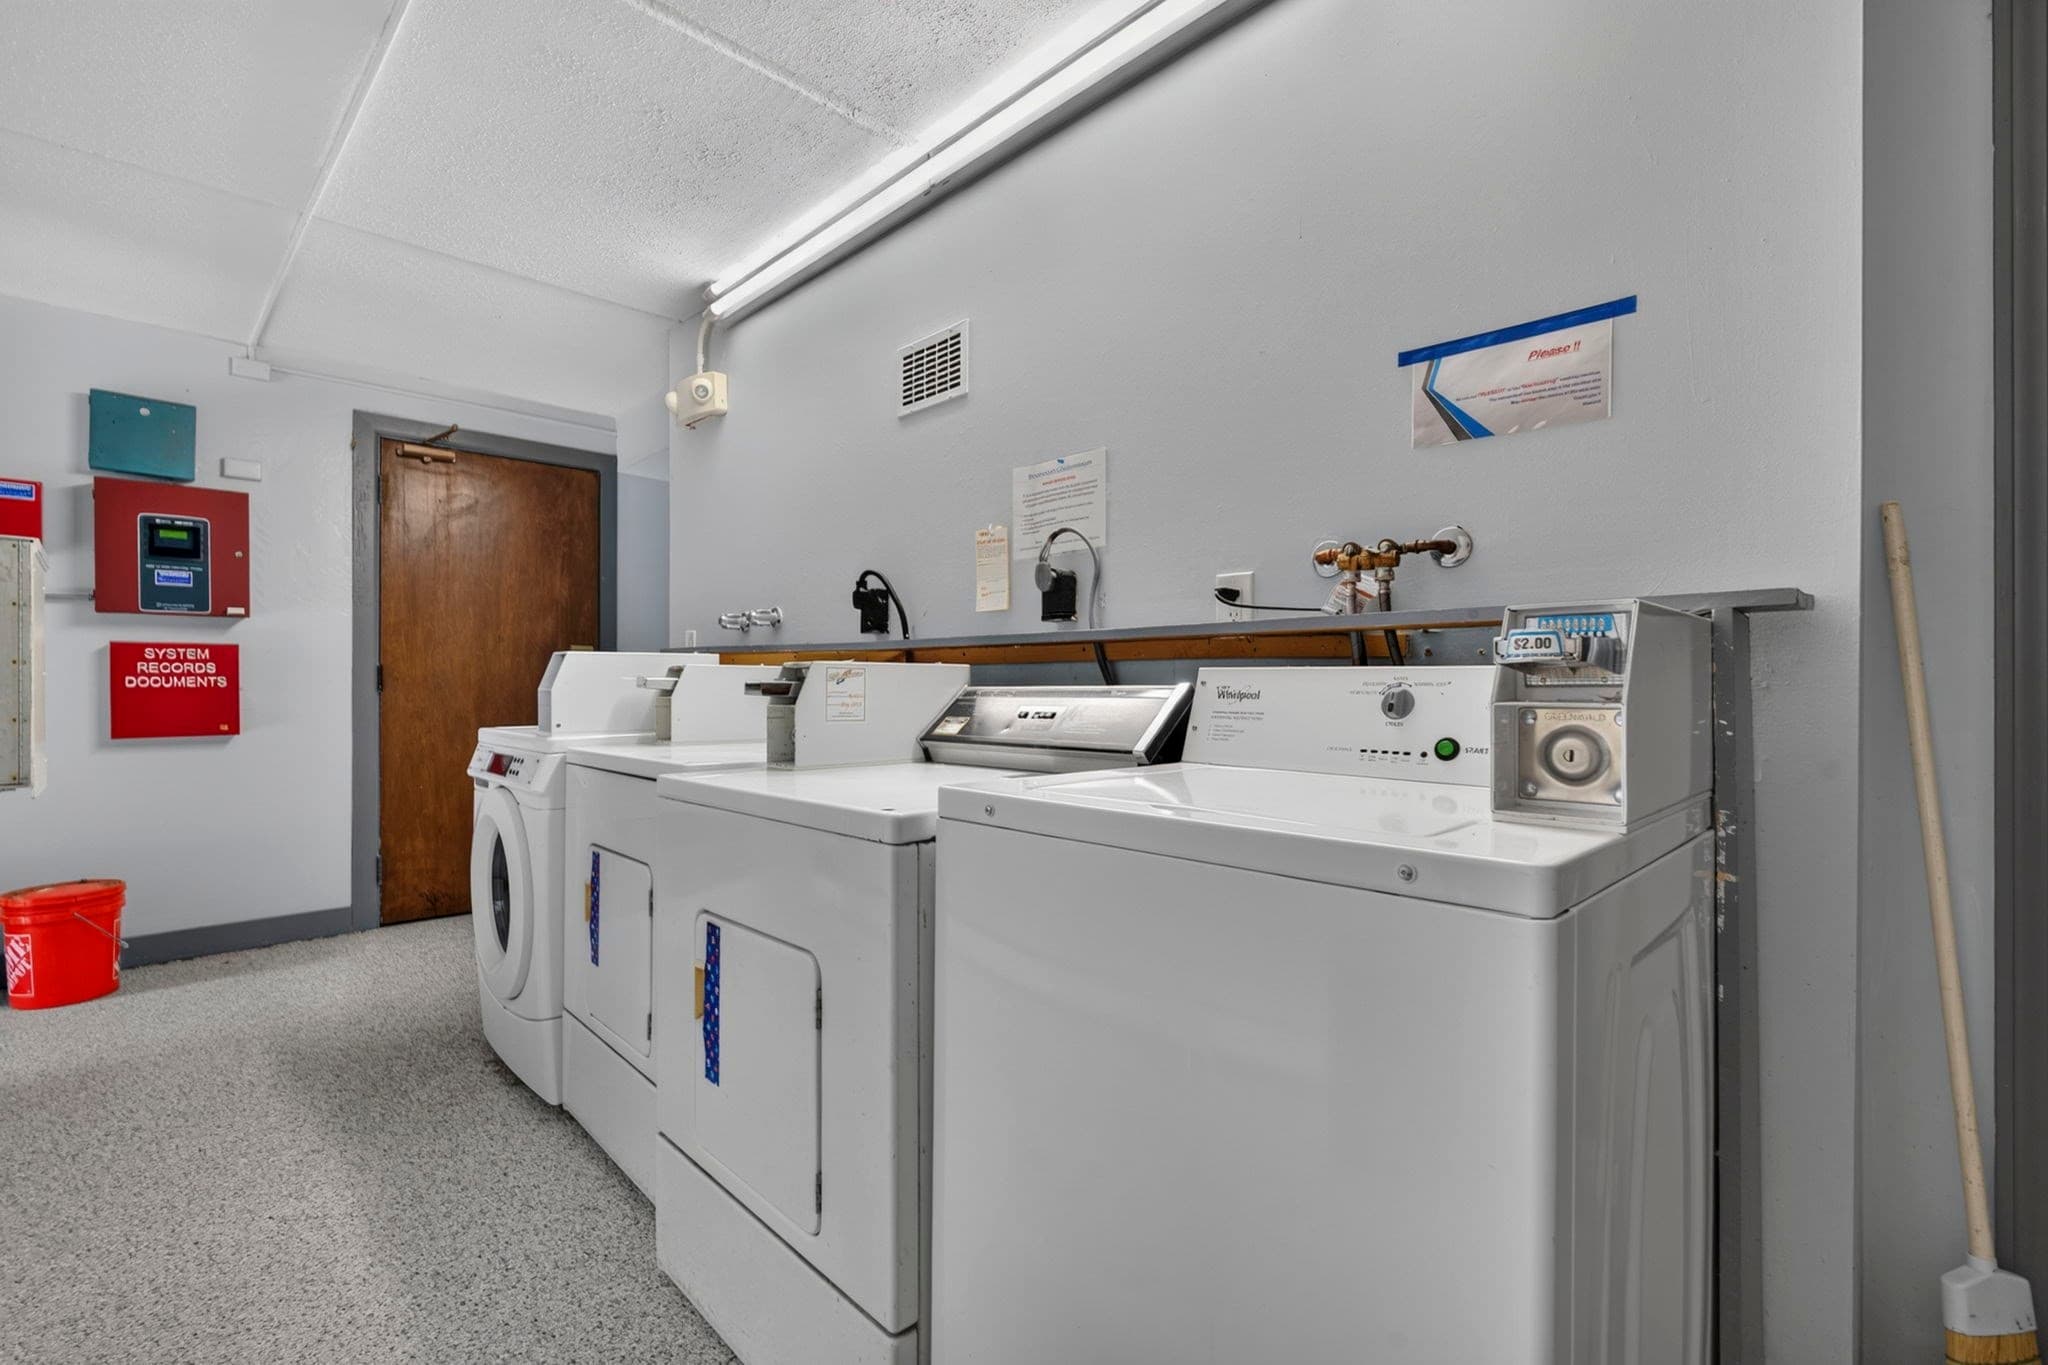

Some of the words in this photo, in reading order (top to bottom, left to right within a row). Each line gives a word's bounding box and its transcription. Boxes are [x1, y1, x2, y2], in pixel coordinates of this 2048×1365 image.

[1528, 344, 1571, 361] Please
[1513, 637, 1552, 650] $2.00
[144, 647, 210, 660] SYSTEM
[137, 661, 217, 674] RECORDS
[124, 676, 228, 688] DOCUMENTS
[1216, 685, 1262, 702] Whirlpool
